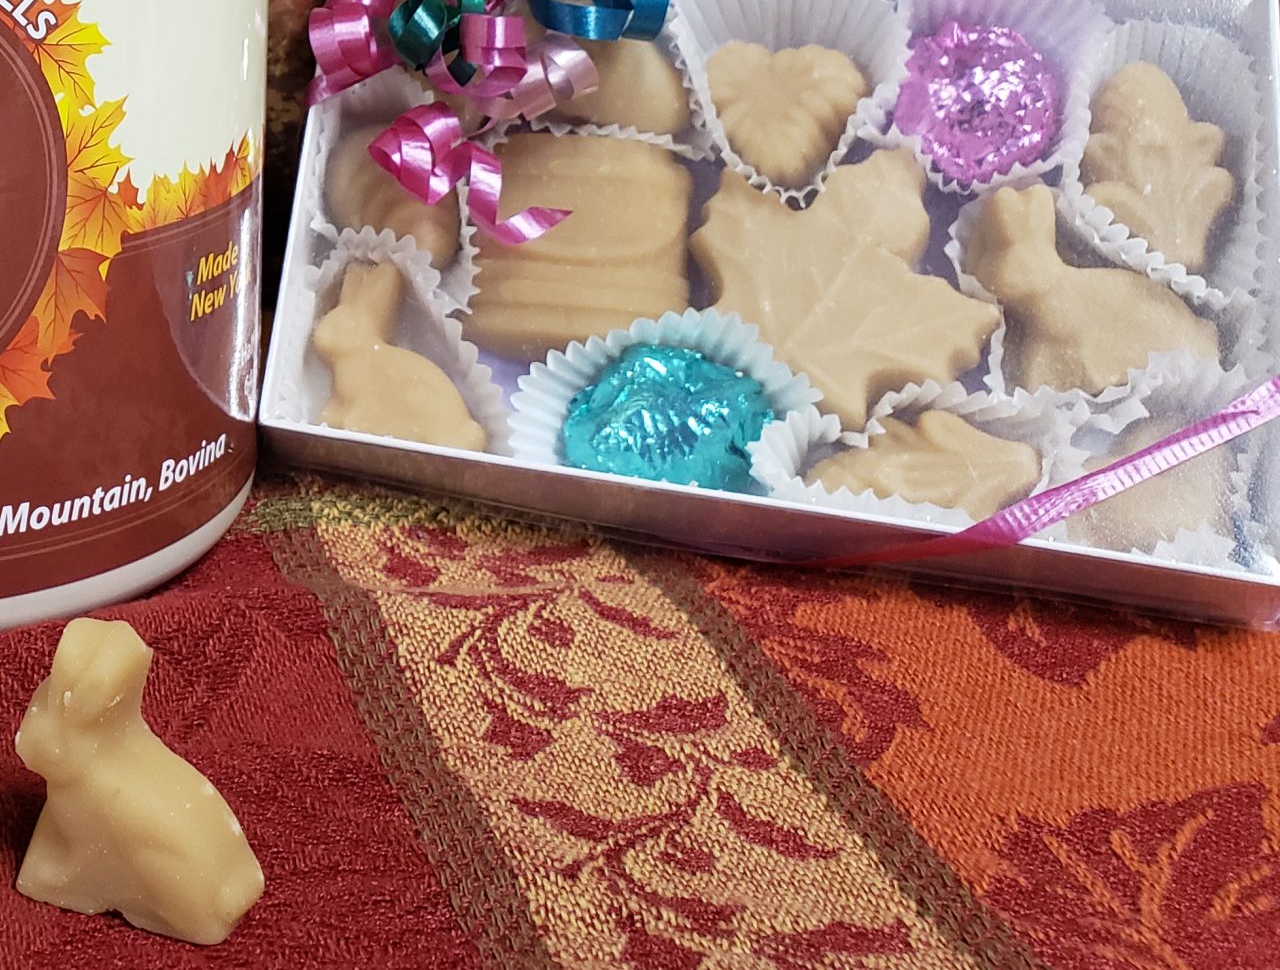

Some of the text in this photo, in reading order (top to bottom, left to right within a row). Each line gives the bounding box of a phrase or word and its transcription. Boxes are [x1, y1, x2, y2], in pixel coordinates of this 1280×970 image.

[197, 240, 239, 286] Made
[190, 284, 227, 322] New
[159, 433, 226, 492] Bovina
